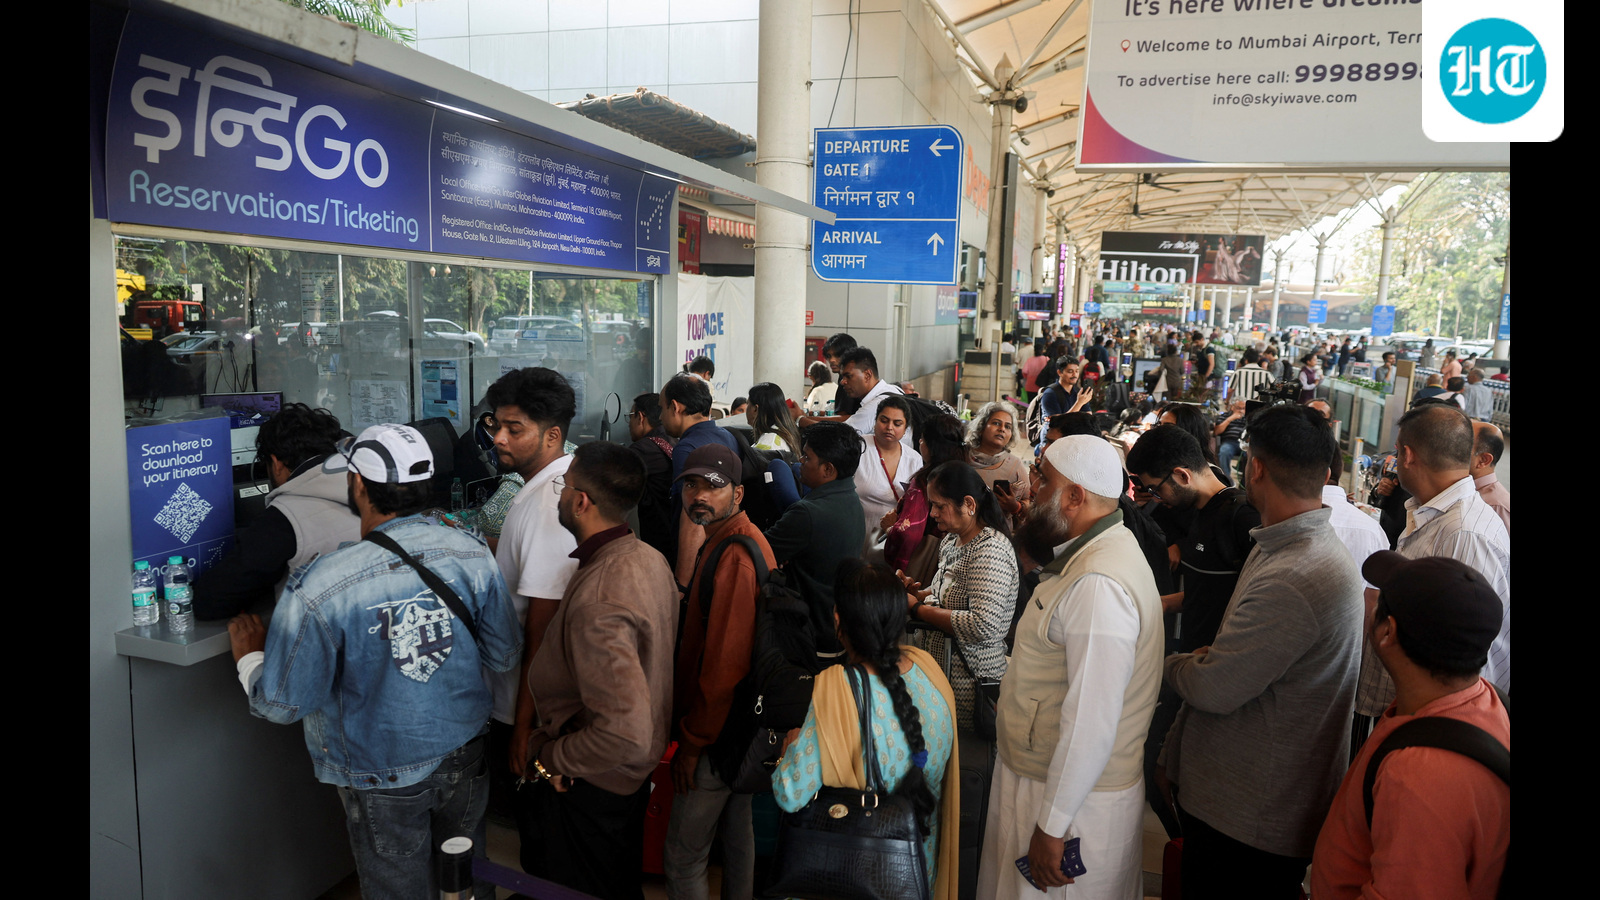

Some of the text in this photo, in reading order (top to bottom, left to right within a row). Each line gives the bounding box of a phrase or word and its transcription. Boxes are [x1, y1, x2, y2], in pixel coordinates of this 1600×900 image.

[1125, 0, 1160, 16] It's
[1169, 0, 1224, 15] here
[1137, 39, 1210, 53] Welcome
[1216, 38, 1233, 50] to
[1239, 34, 1307, 50] Mumbai
[1312, 33, 1381, 49] Airport,
[1117, 62, 1422, 87] To advertise here call: 9998899
[1212, 93, 1358, 107] info@skyiwave.com
[442, 131, 469, 147] स्थानिक
[824, 139, 910, 154] DEPARTURE
[823, 163, 870, 177] GATE 1
[441, 174, 459, 187] Local
[459, 178, 480, 192] Office:
[502, 187, 532, 202] InterGlobe
[532, 193, 553, 206] Aviation
[552, 198, 571, 211] Limited,
[570, 201, 588, 213] Terminal
[441, 189, 474, 205] Santacruz
[473, 195, 494, 210] (East),
[494, 199, 519, 214] Mumbai,
[518, 204, 552, 219] Maharashtra
[823, 185, 916, 209] निर्गमन द्वार १
[129, 169, 420, 243] Reservations/Ticketing
[441, 214, 475, 228] Registered
[474, 219, 493, 231] Office:
[493, 222, 513, 234] IndiGo,
[512, 225, 539, 237] InterGlobe
[538, 228, 558, 240] Aviation
[573, 234, 586, 245] Upper
[585, 236, 601, 246] Ground
[442, 227, 464, 240] House,
[463, 230, 479, 241] Gate
[479, 232, 489, 243] No.
[495, 234, 518, 246] Western
[517, 237, 532, 250] Wing,
[540, 241, 560, 252] Janpath,
[559, 243, 570, 253] New
[821, 230, 882, 244] ARRIVAL
[821, 254, 868, 269] आगमन
[1097, 259, 1188, 284] Hilton
[141, 437, 213, 457] Scan here to
[142, 450, 203, 471] download
[143, 463, 218, 488] your itinerary
